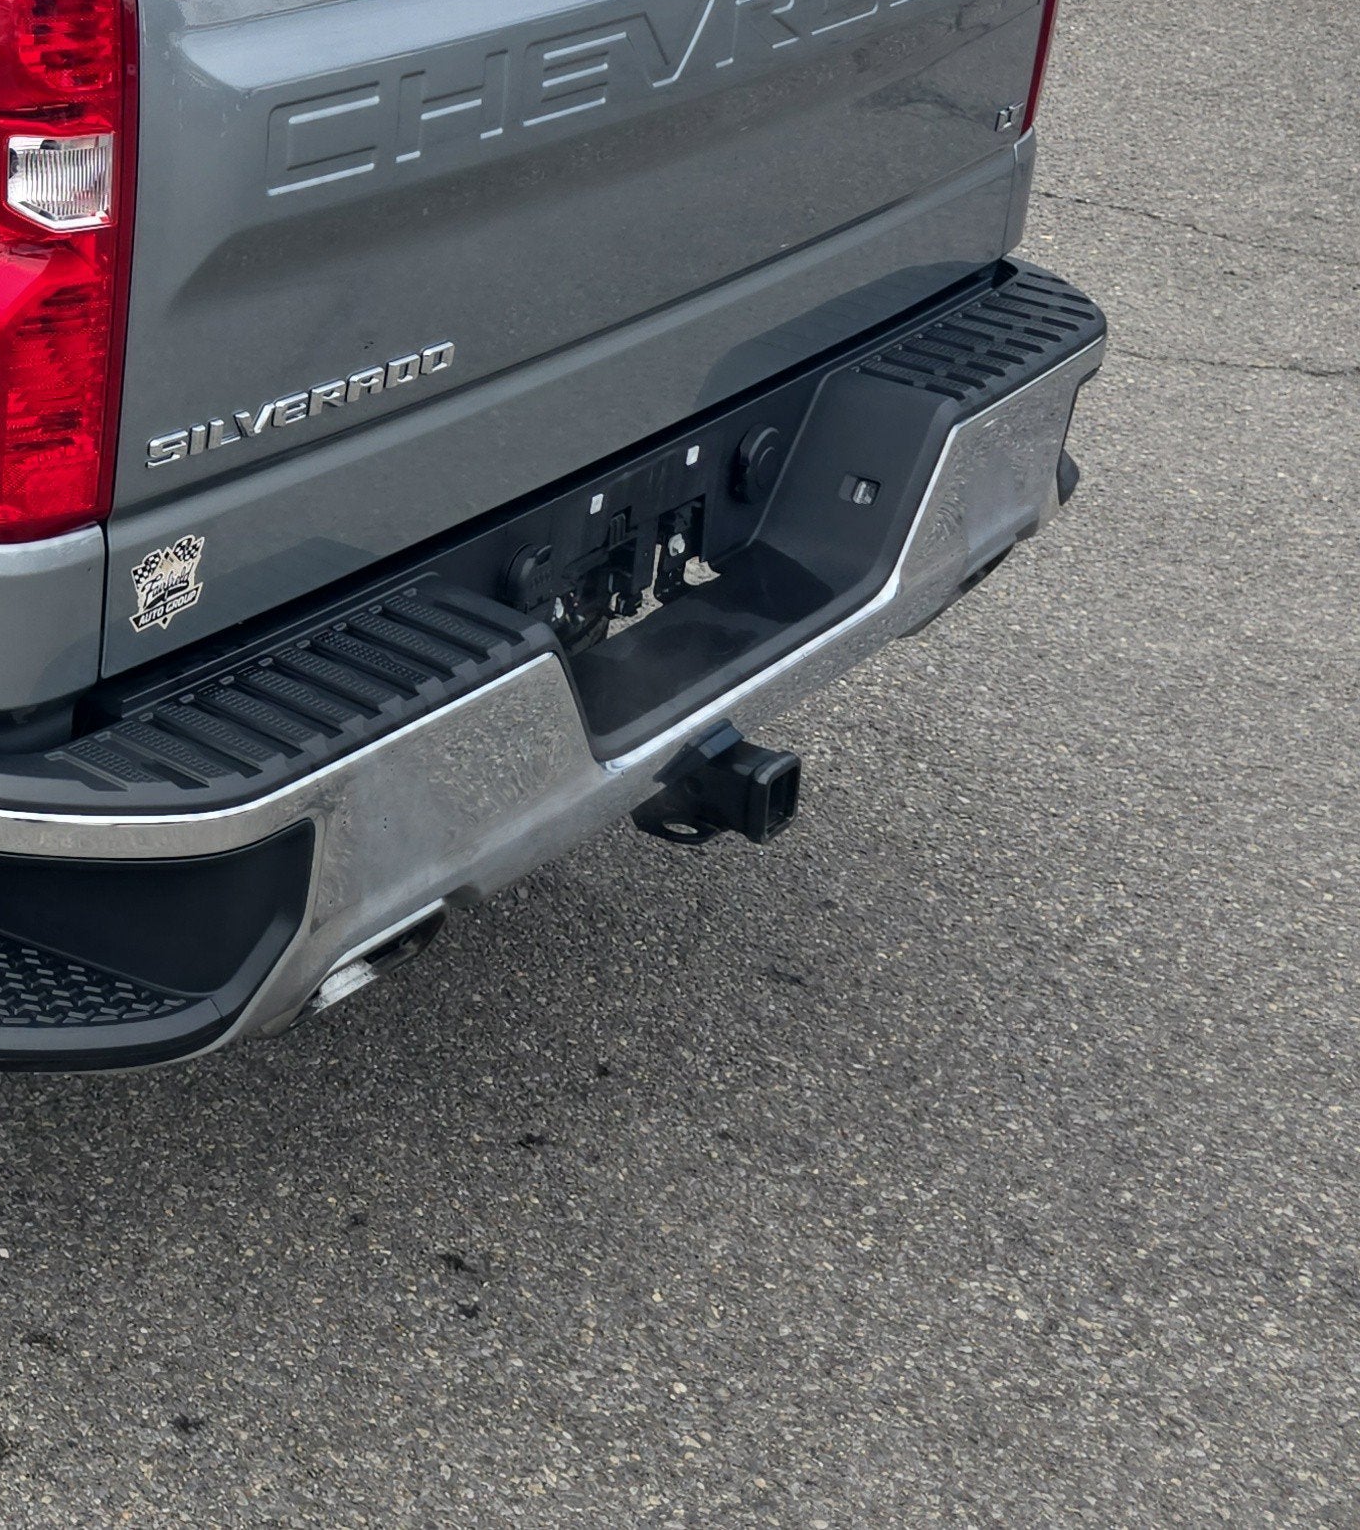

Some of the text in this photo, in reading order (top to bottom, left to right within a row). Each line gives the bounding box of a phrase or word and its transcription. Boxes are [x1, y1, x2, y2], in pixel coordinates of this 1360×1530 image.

[145, 340, 455, 469] SILVERADO
[139, 590, 197, 626] AUTO GROUP
